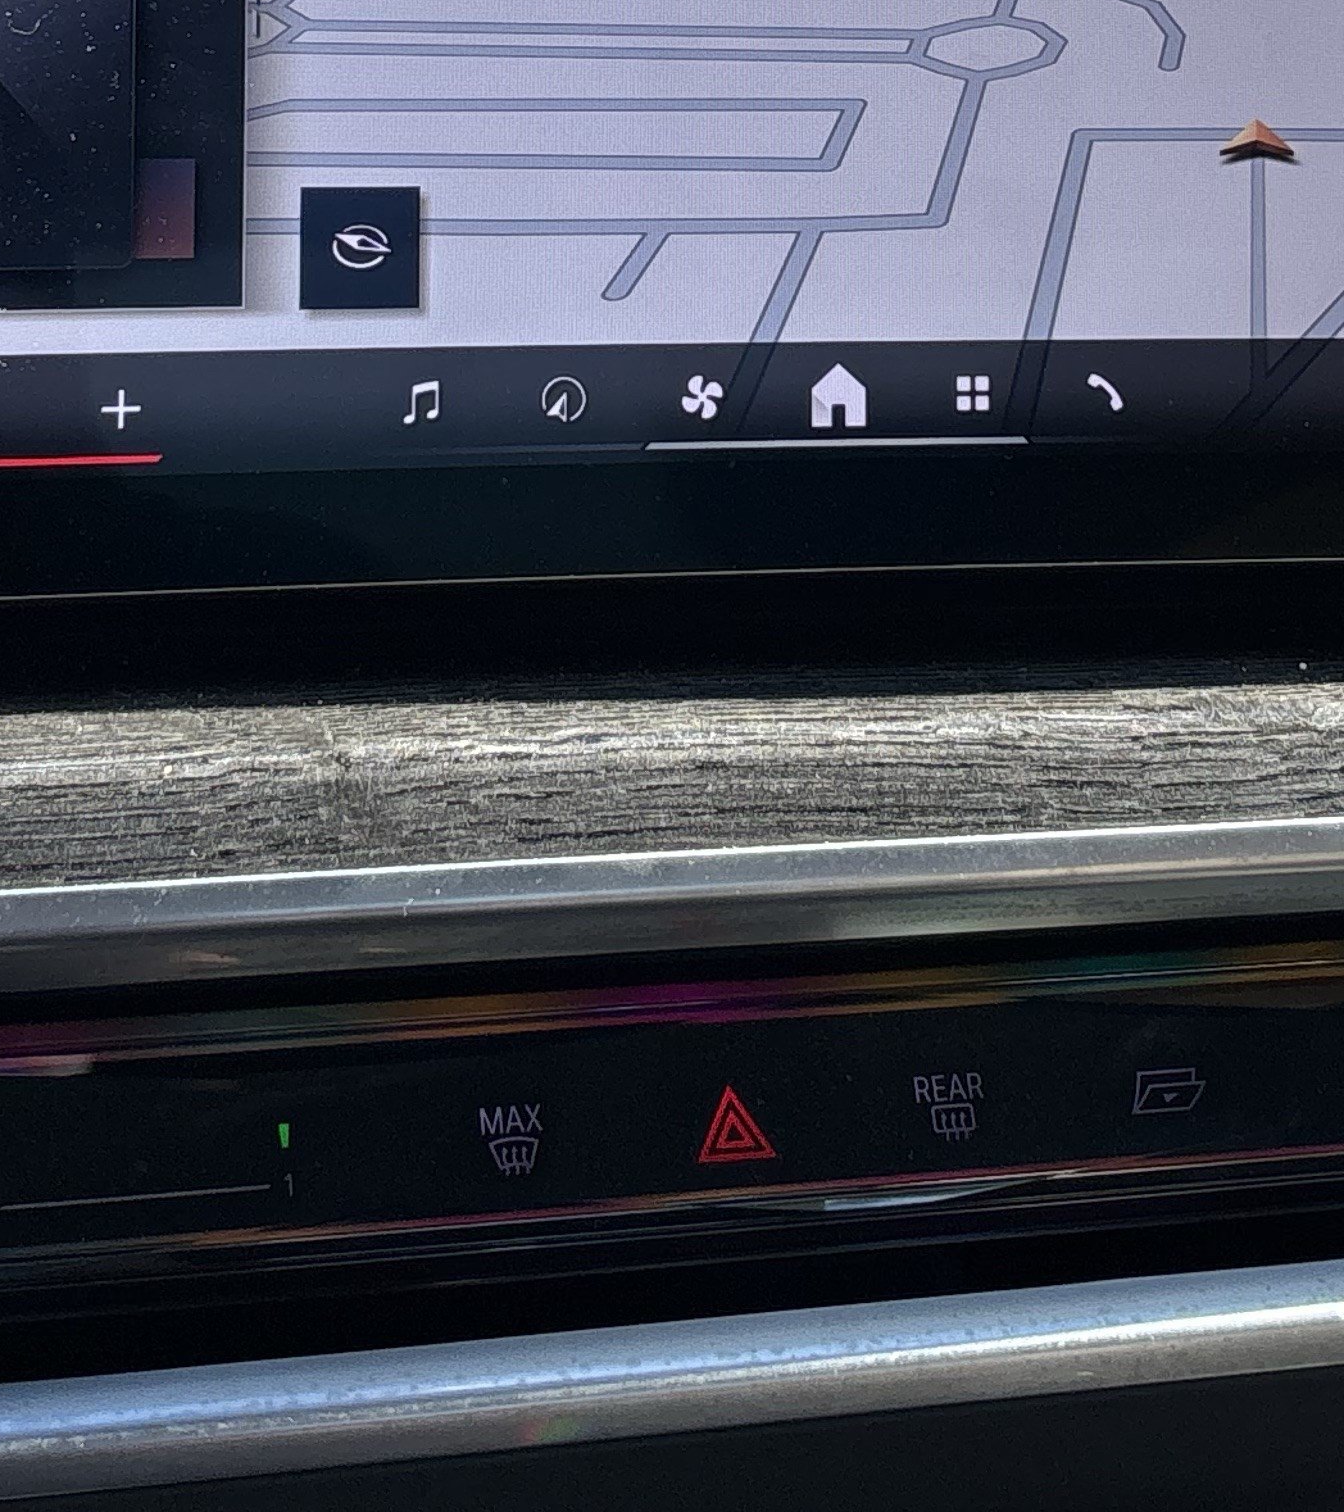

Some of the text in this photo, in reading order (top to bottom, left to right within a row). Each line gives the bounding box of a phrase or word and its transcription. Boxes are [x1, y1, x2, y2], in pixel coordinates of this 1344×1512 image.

[913, 1072, 984, 1104] REAR
[479, 1103, 543, 1136] MAX
[283, 1172, 294, 1197] 1
